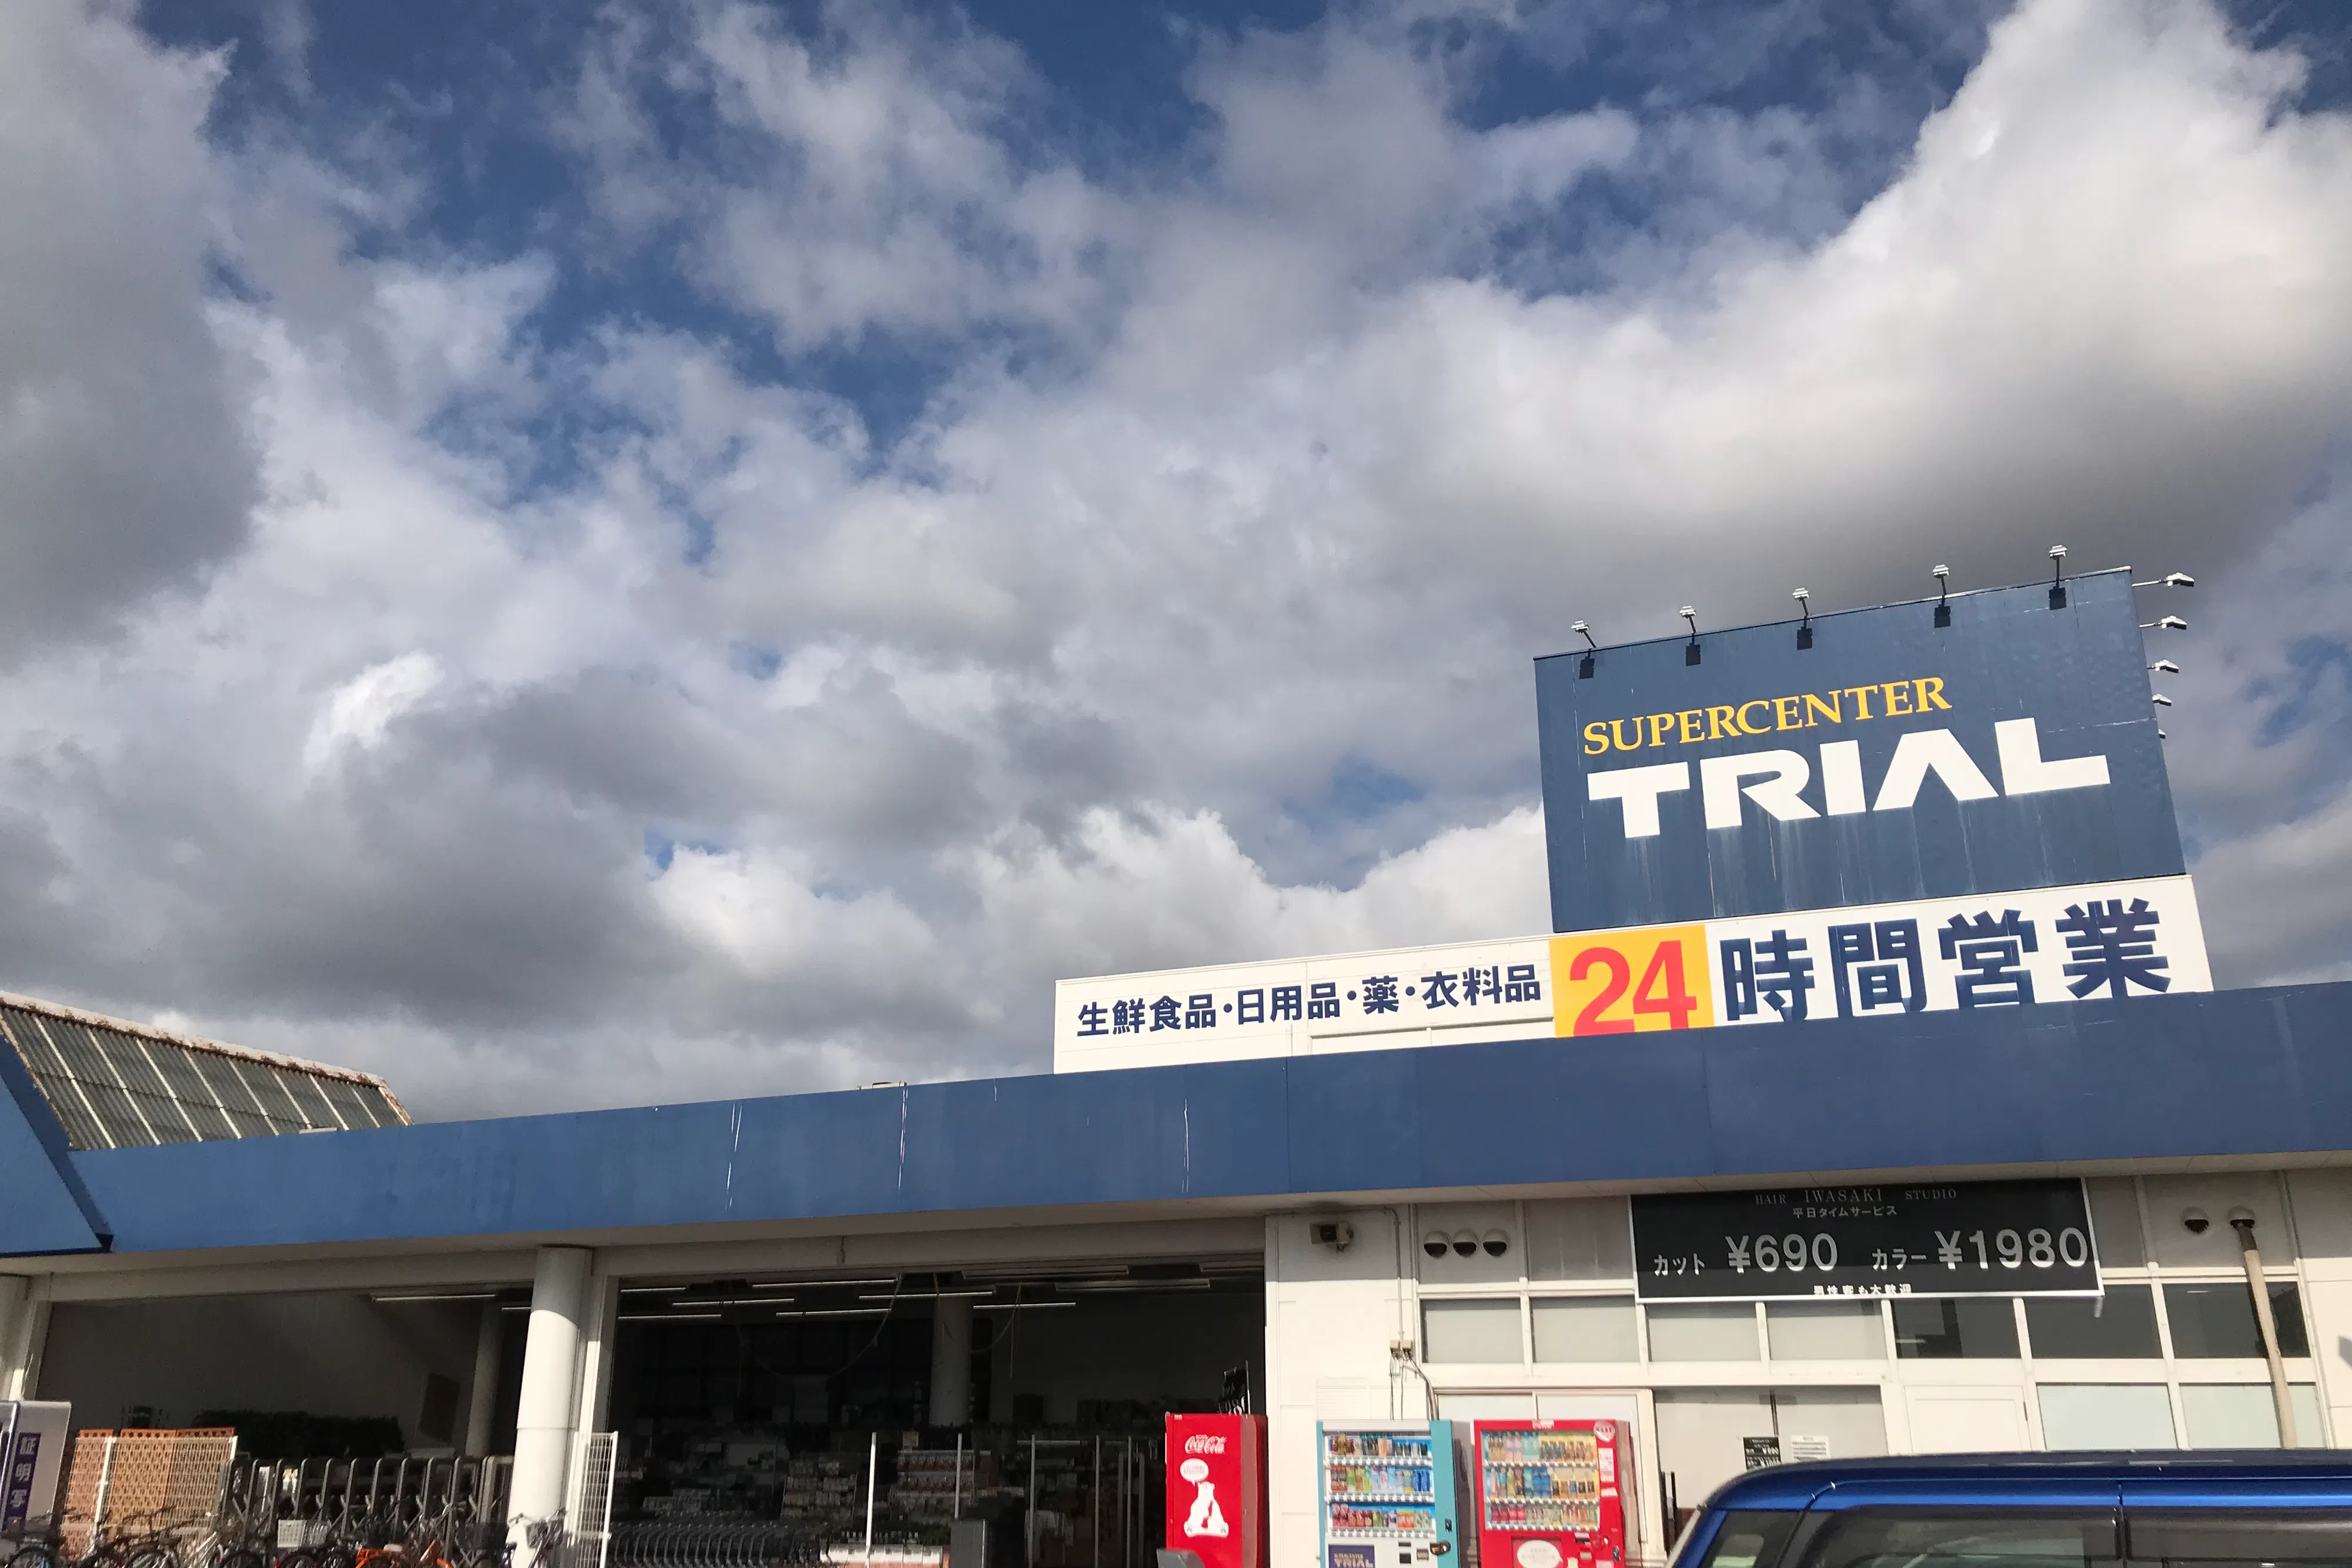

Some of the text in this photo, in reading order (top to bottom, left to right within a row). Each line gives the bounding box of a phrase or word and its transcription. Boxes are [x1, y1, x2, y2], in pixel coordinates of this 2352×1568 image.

[1583, 676, 1952, 755] SUPERCENTER
[1587, 717, 2112, 839] TRIAL
[1755, 1188, 1957, 1205] HAIR IWASAKI STUDIO
[1792, 1205, 1897, 1219] 平日タイムサービス
[1653, 1227, 2088, 1276] カット ¥690 カラー ¥1980
[7, 1436, 37, 1531] 証明写
